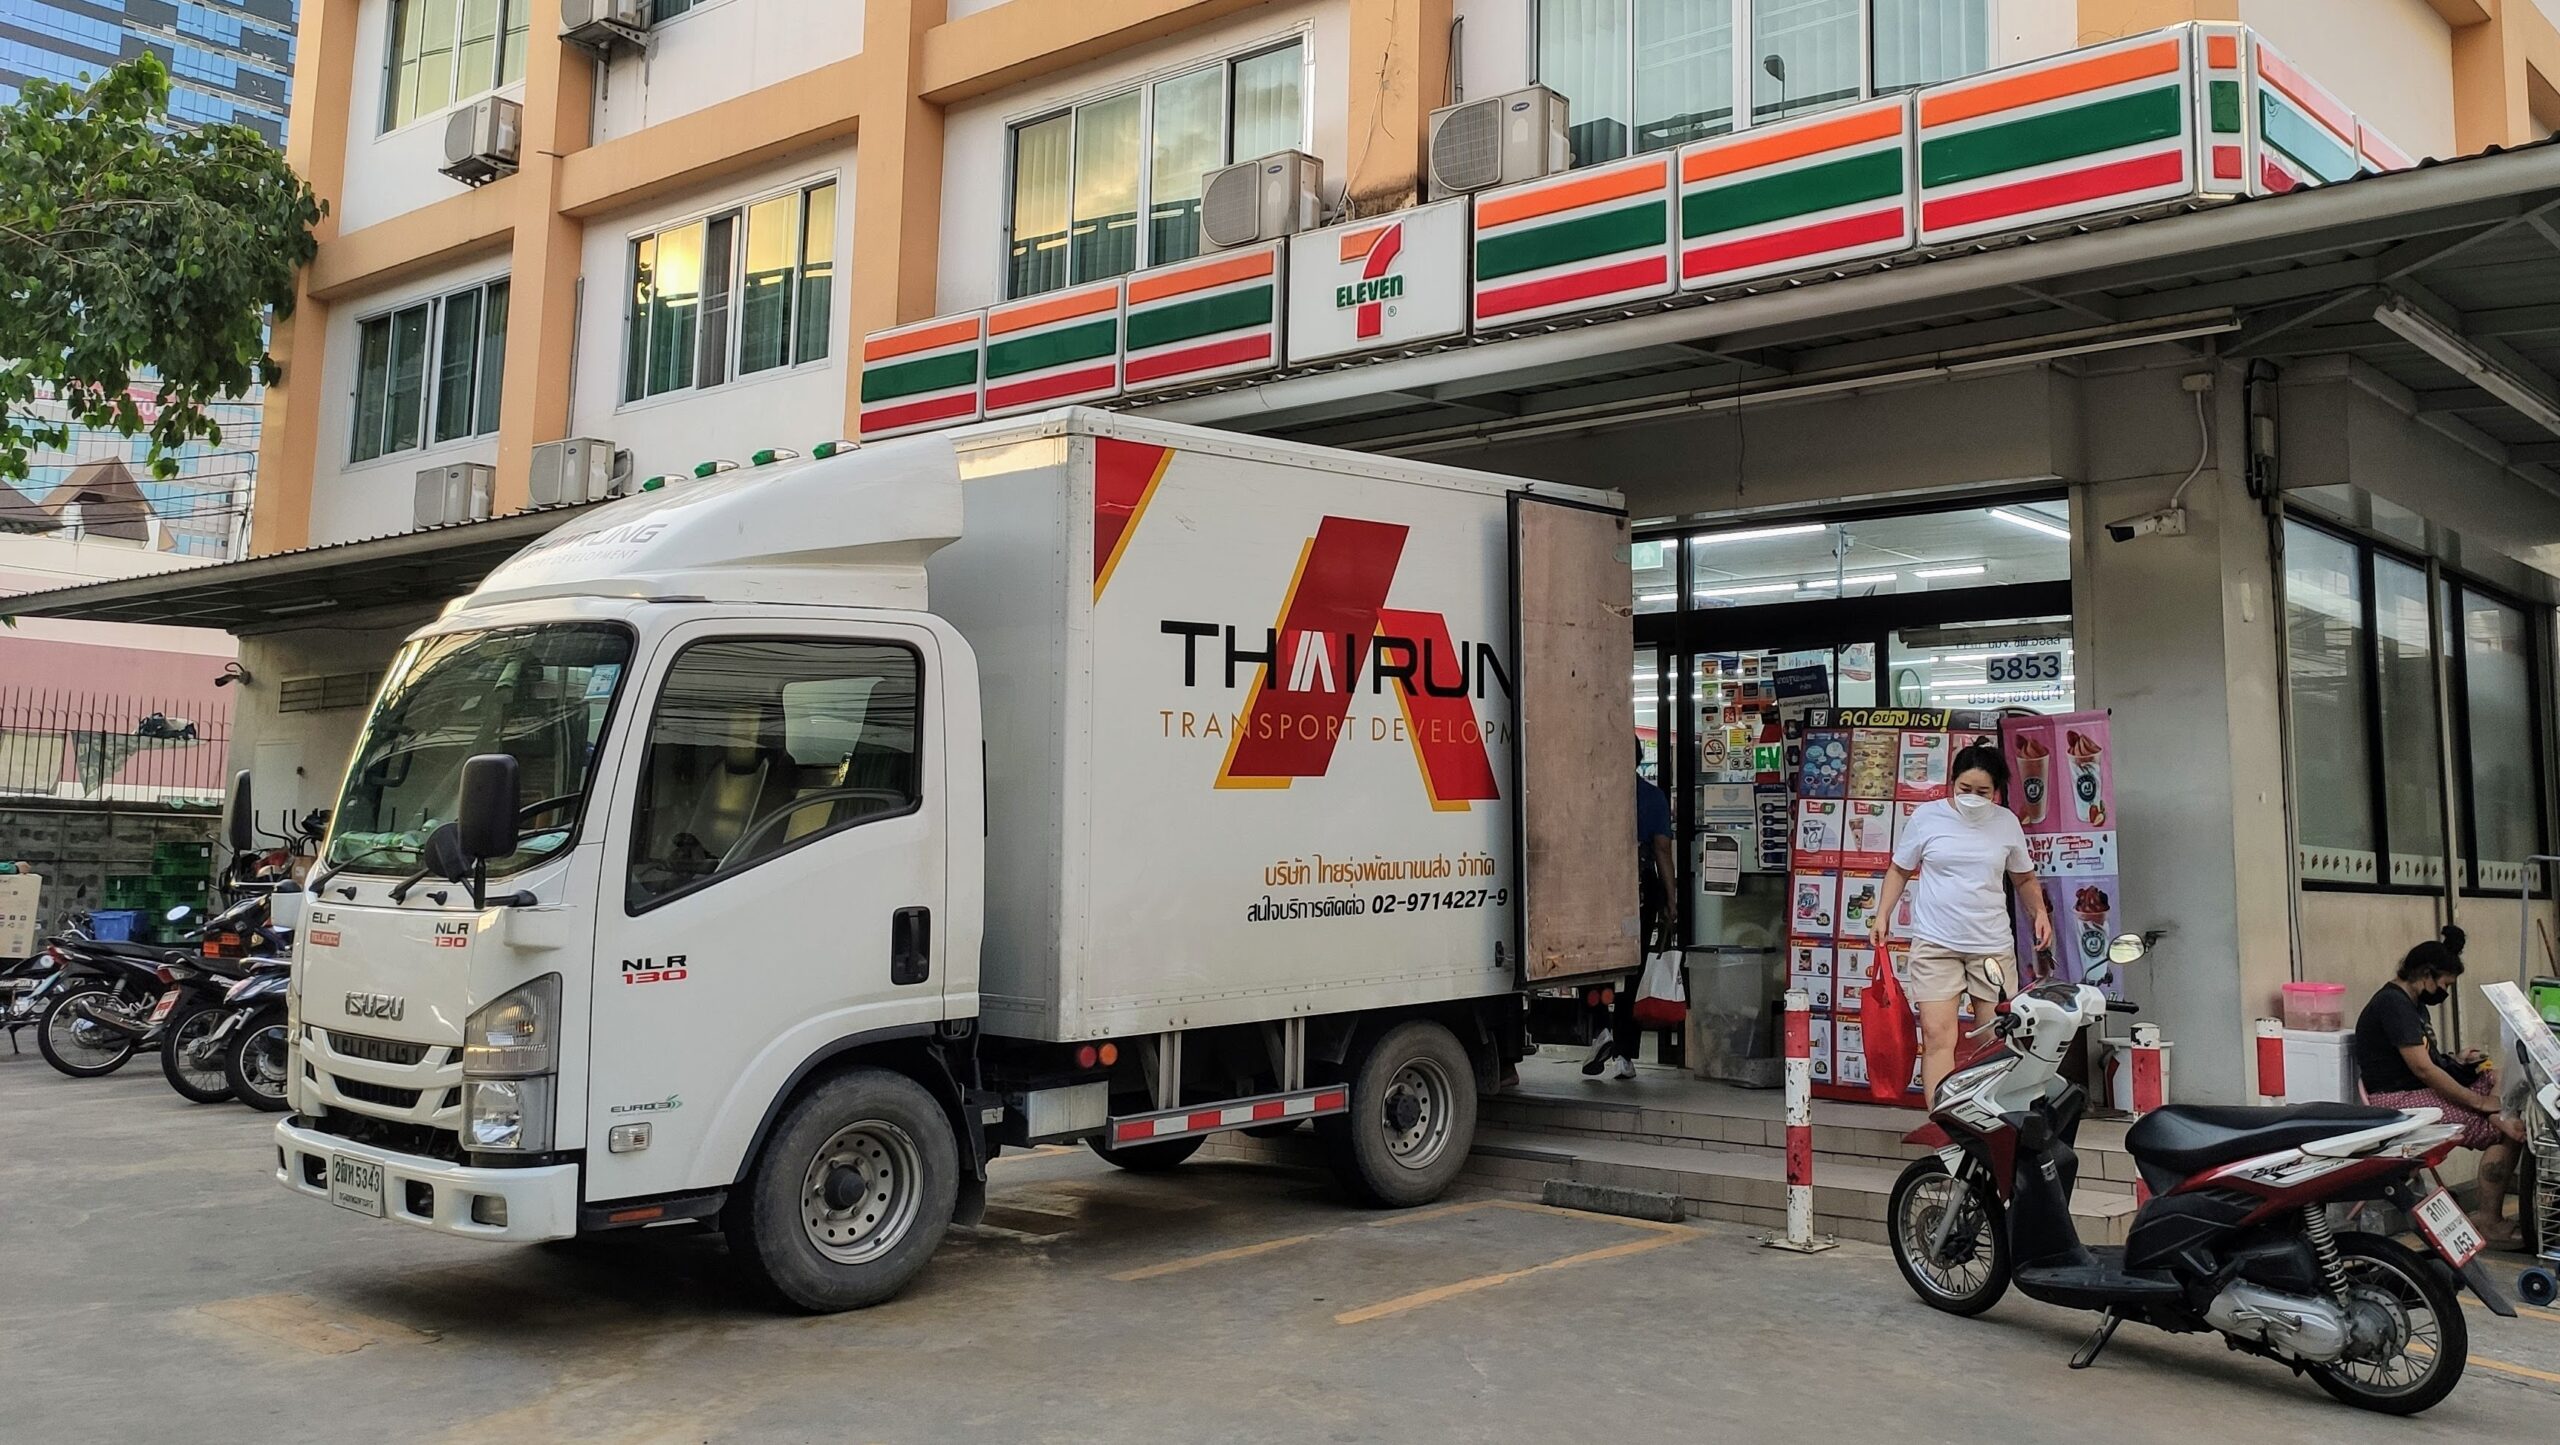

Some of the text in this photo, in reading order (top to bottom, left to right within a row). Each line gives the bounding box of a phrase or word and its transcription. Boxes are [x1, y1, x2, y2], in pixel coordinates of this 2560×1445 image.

[1340, 221, 1403, 340] 7
[1990, 655, 2060, 680] 5853
[1160, 711, 1357, 741] TRANSPORT
[1265, 857, 1311, 887] บริษัท
[1457, 851, 1496, 878] จำกัด
[312, 912, 336, 924] ELF
[1247, 888, 1509, 923] สนใจบริการติดต่อ 02-9714227-9
[435, 922, 470, 935] NLR
[434, 936, 468, 948] 130
[622, 955, 687, 972] NLR
[622, 969, 688, 985] 130
[345, 991, 405, 1021] ISUZU
[355, 1164, 380, 1193] 5343
[2453, 1230, 2476, 1256] 453
